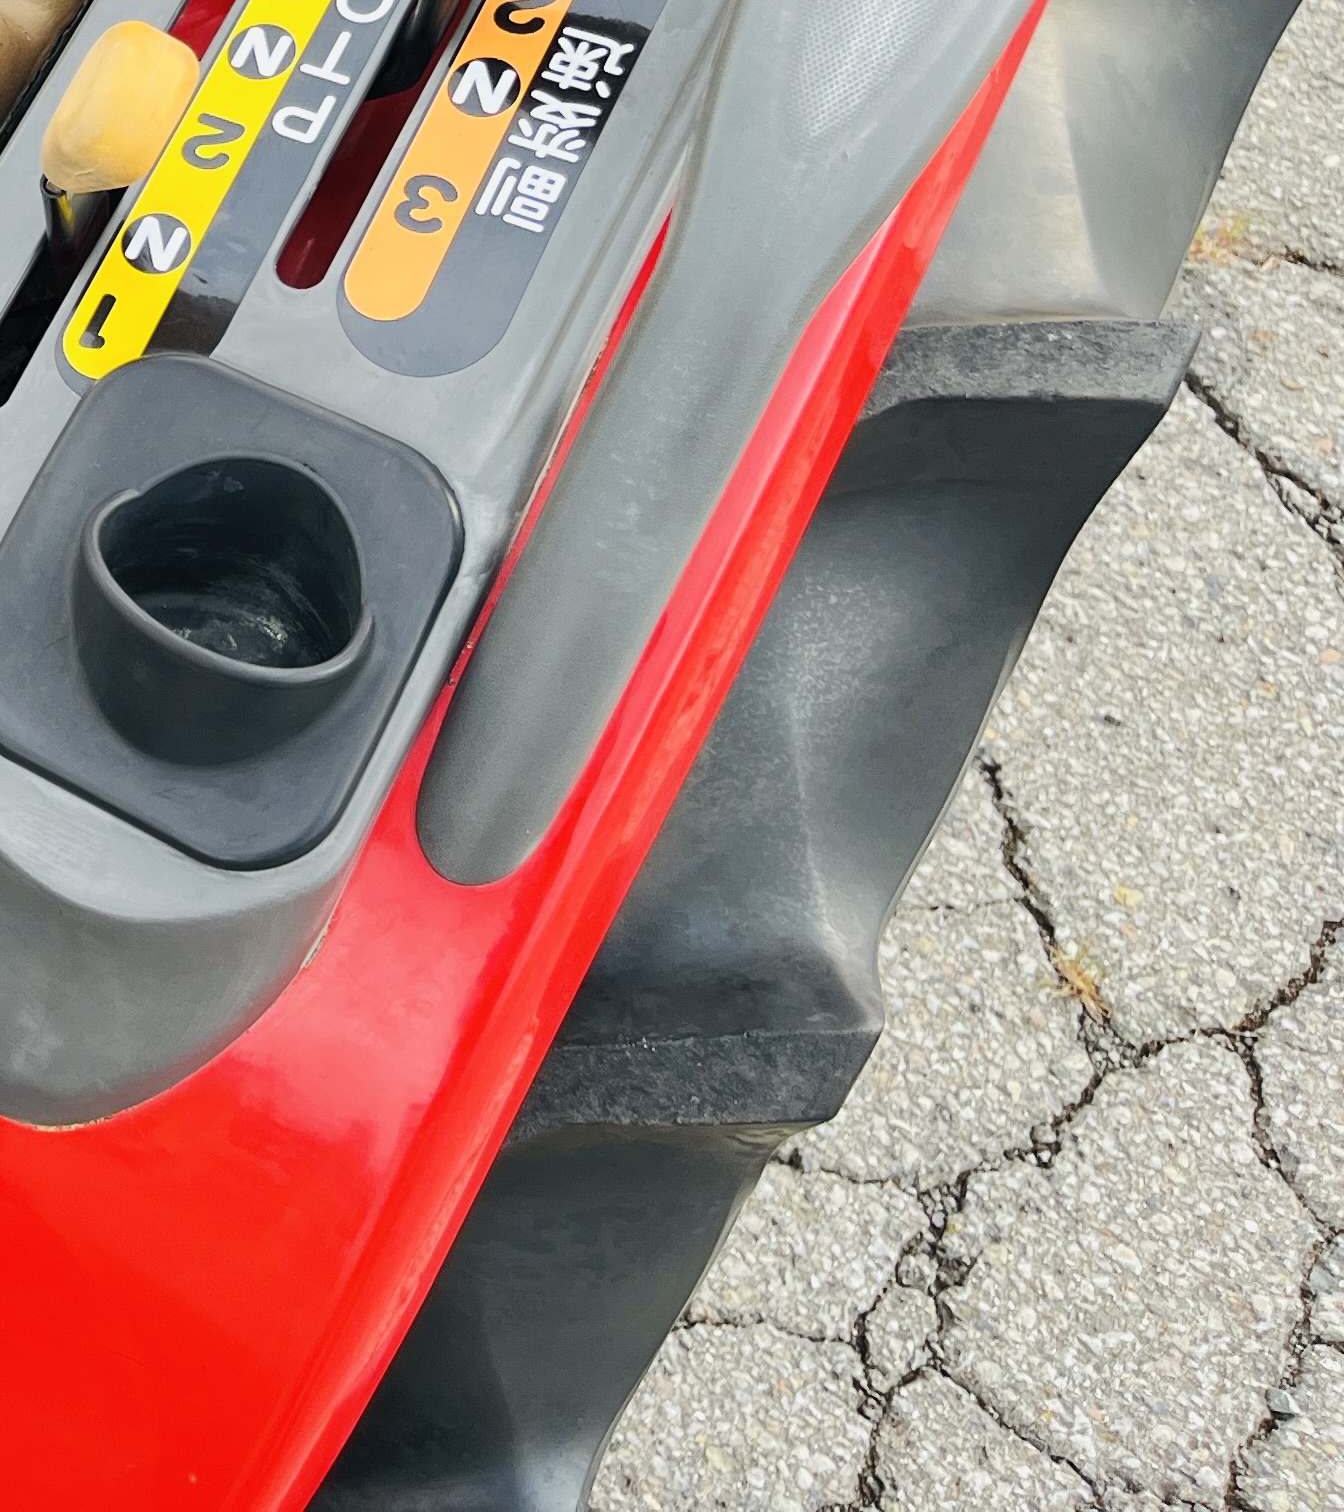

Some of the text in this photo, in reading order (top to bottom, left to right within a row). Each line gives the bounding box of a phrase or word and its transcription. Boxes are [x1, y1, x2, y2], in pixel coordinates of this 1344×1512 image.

[232, 28, 295, 76] N
[452, 61, 517, 115] N
[181, 113, 247, 170] 2
[476, 26, 636, 233] 副変速
[394, 175, 459, 232] 3
[125, 218, 189, 268] N
[78, 294, 118, 350] 1
